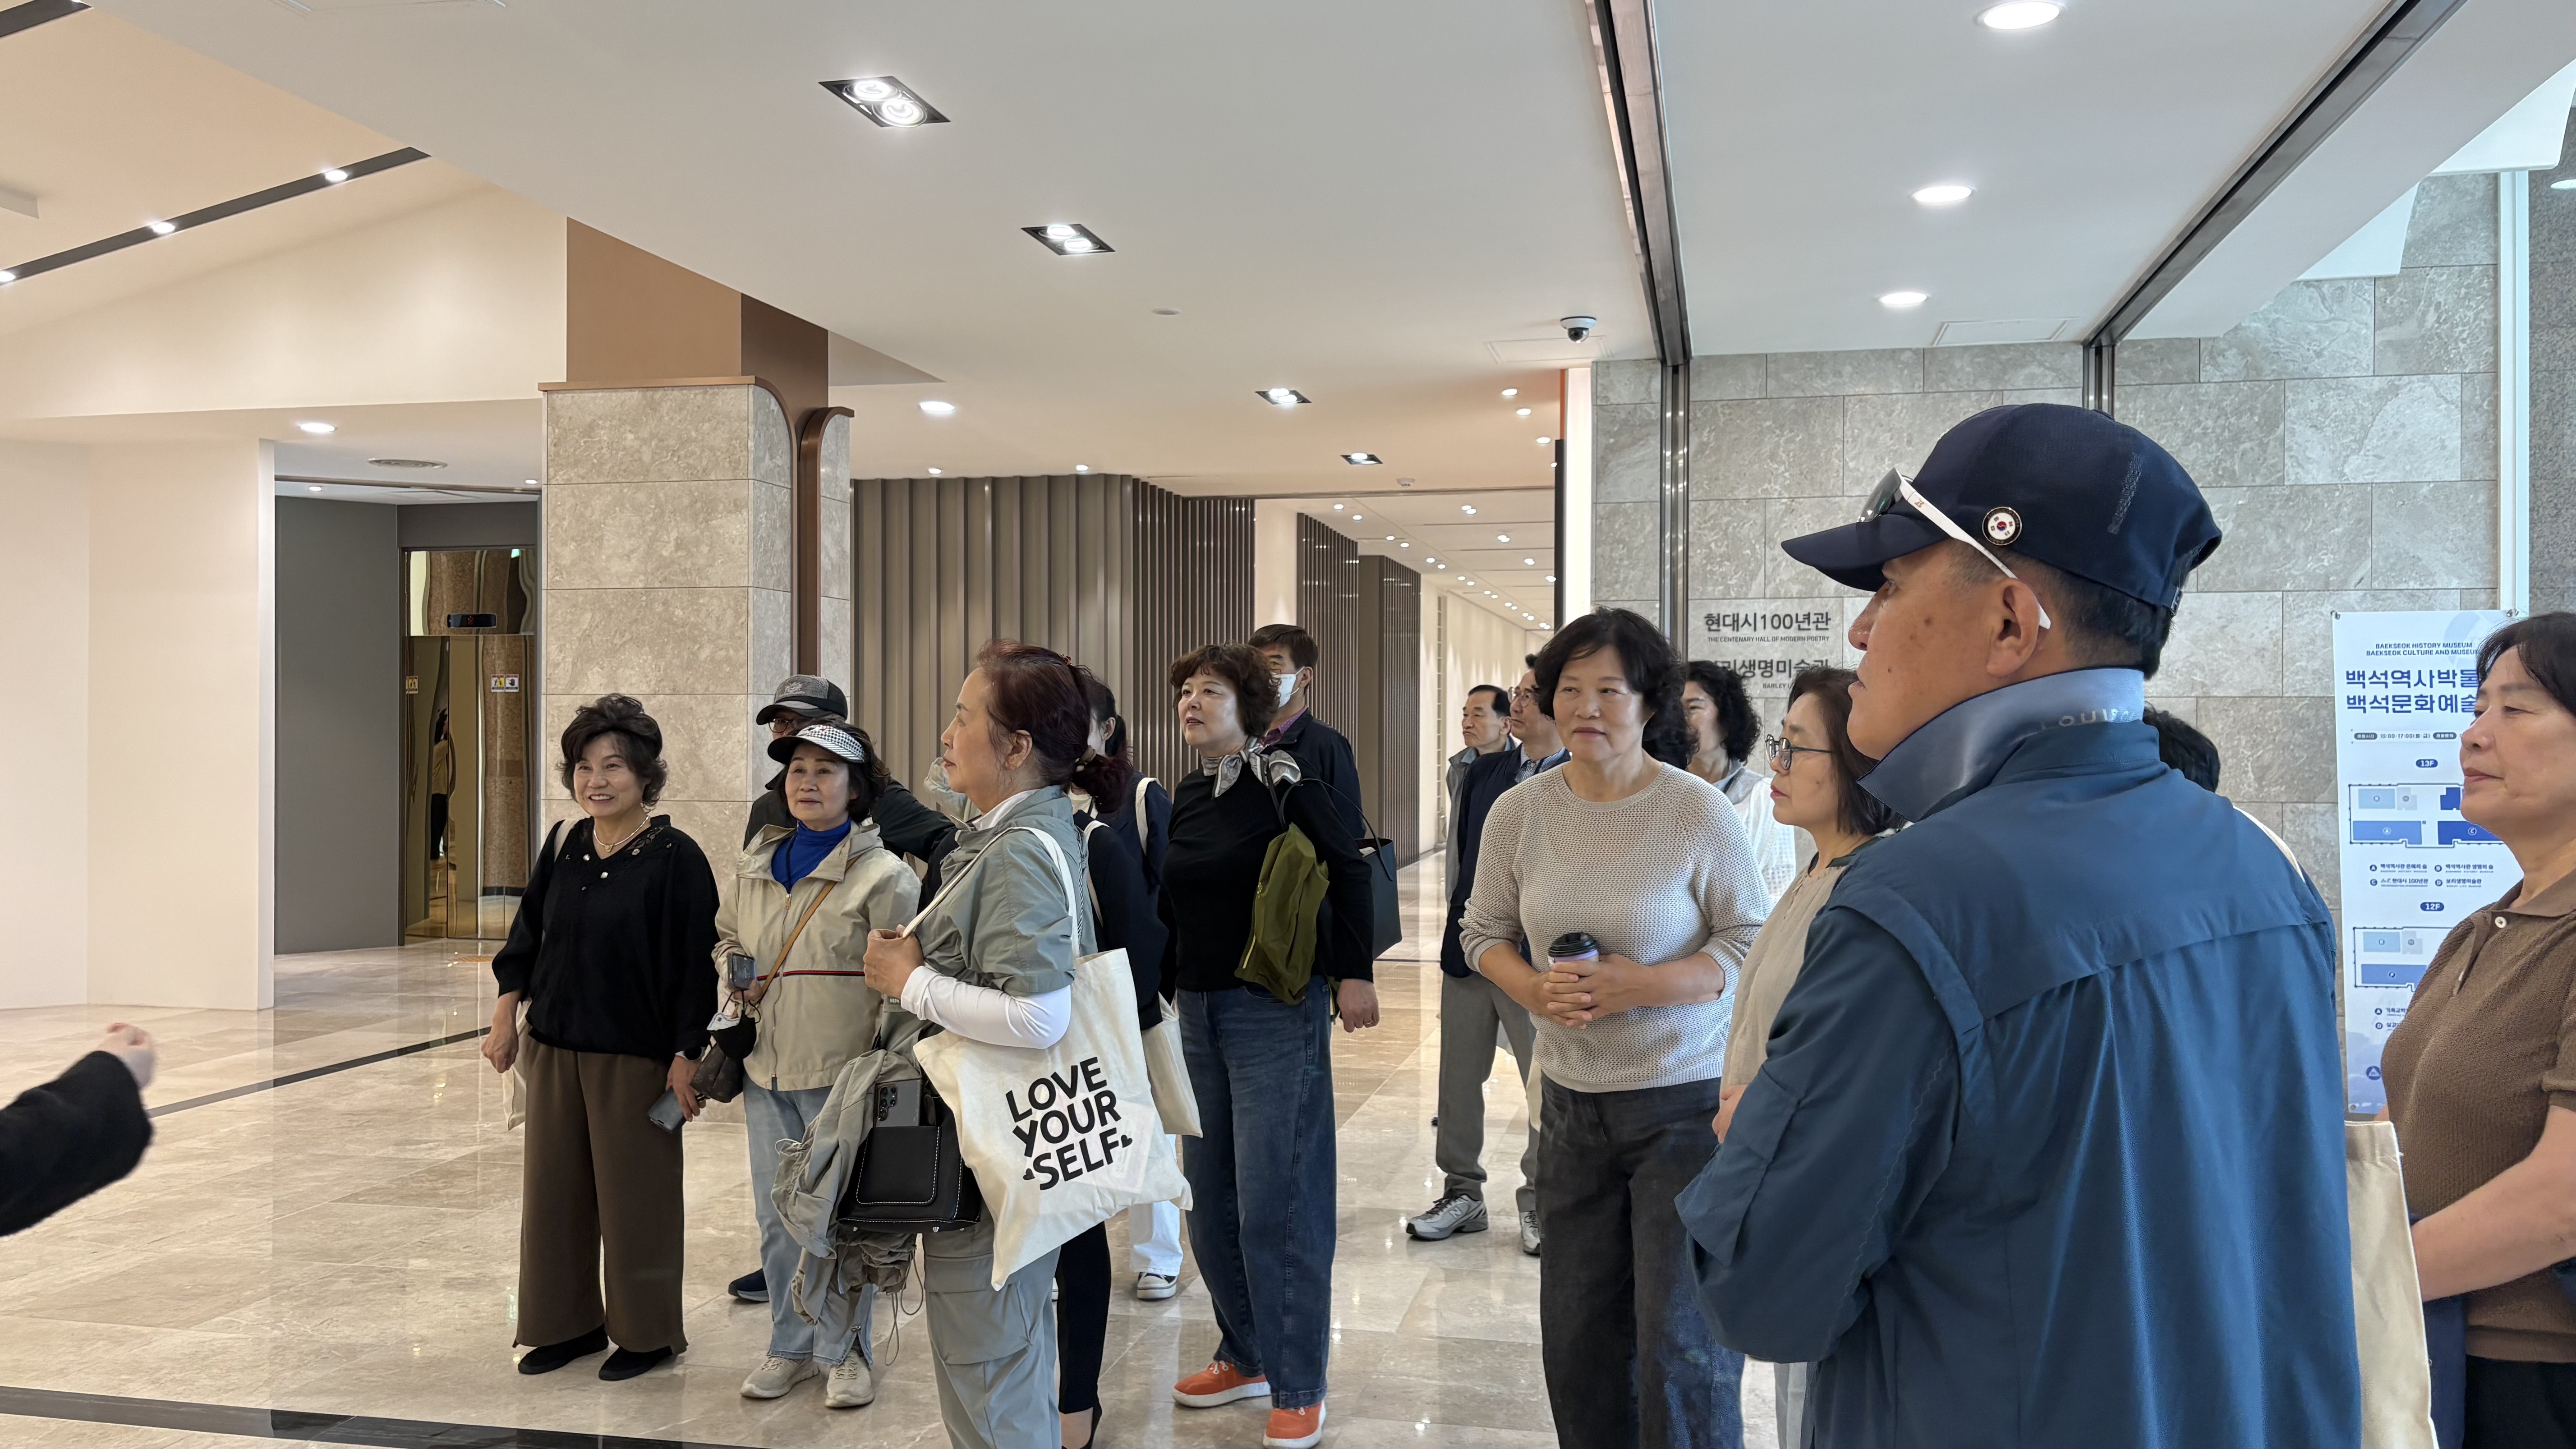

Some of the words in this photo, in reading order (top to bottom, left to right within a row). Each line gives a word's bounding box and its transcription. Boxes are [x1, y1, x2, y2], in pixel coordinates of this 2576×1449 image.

[1704, 612, 1831, 632] 현대시100년관
[2346, 670, 2479, 689] 백석역사박물
[2346, 694, 2476, 713] 백석문화예술
[1006, 1057, 1107, 1123] LOVE
[1012, 1090, 1122, 1158] YOUR
[1033, 1127, 1119, 1191] SELF
